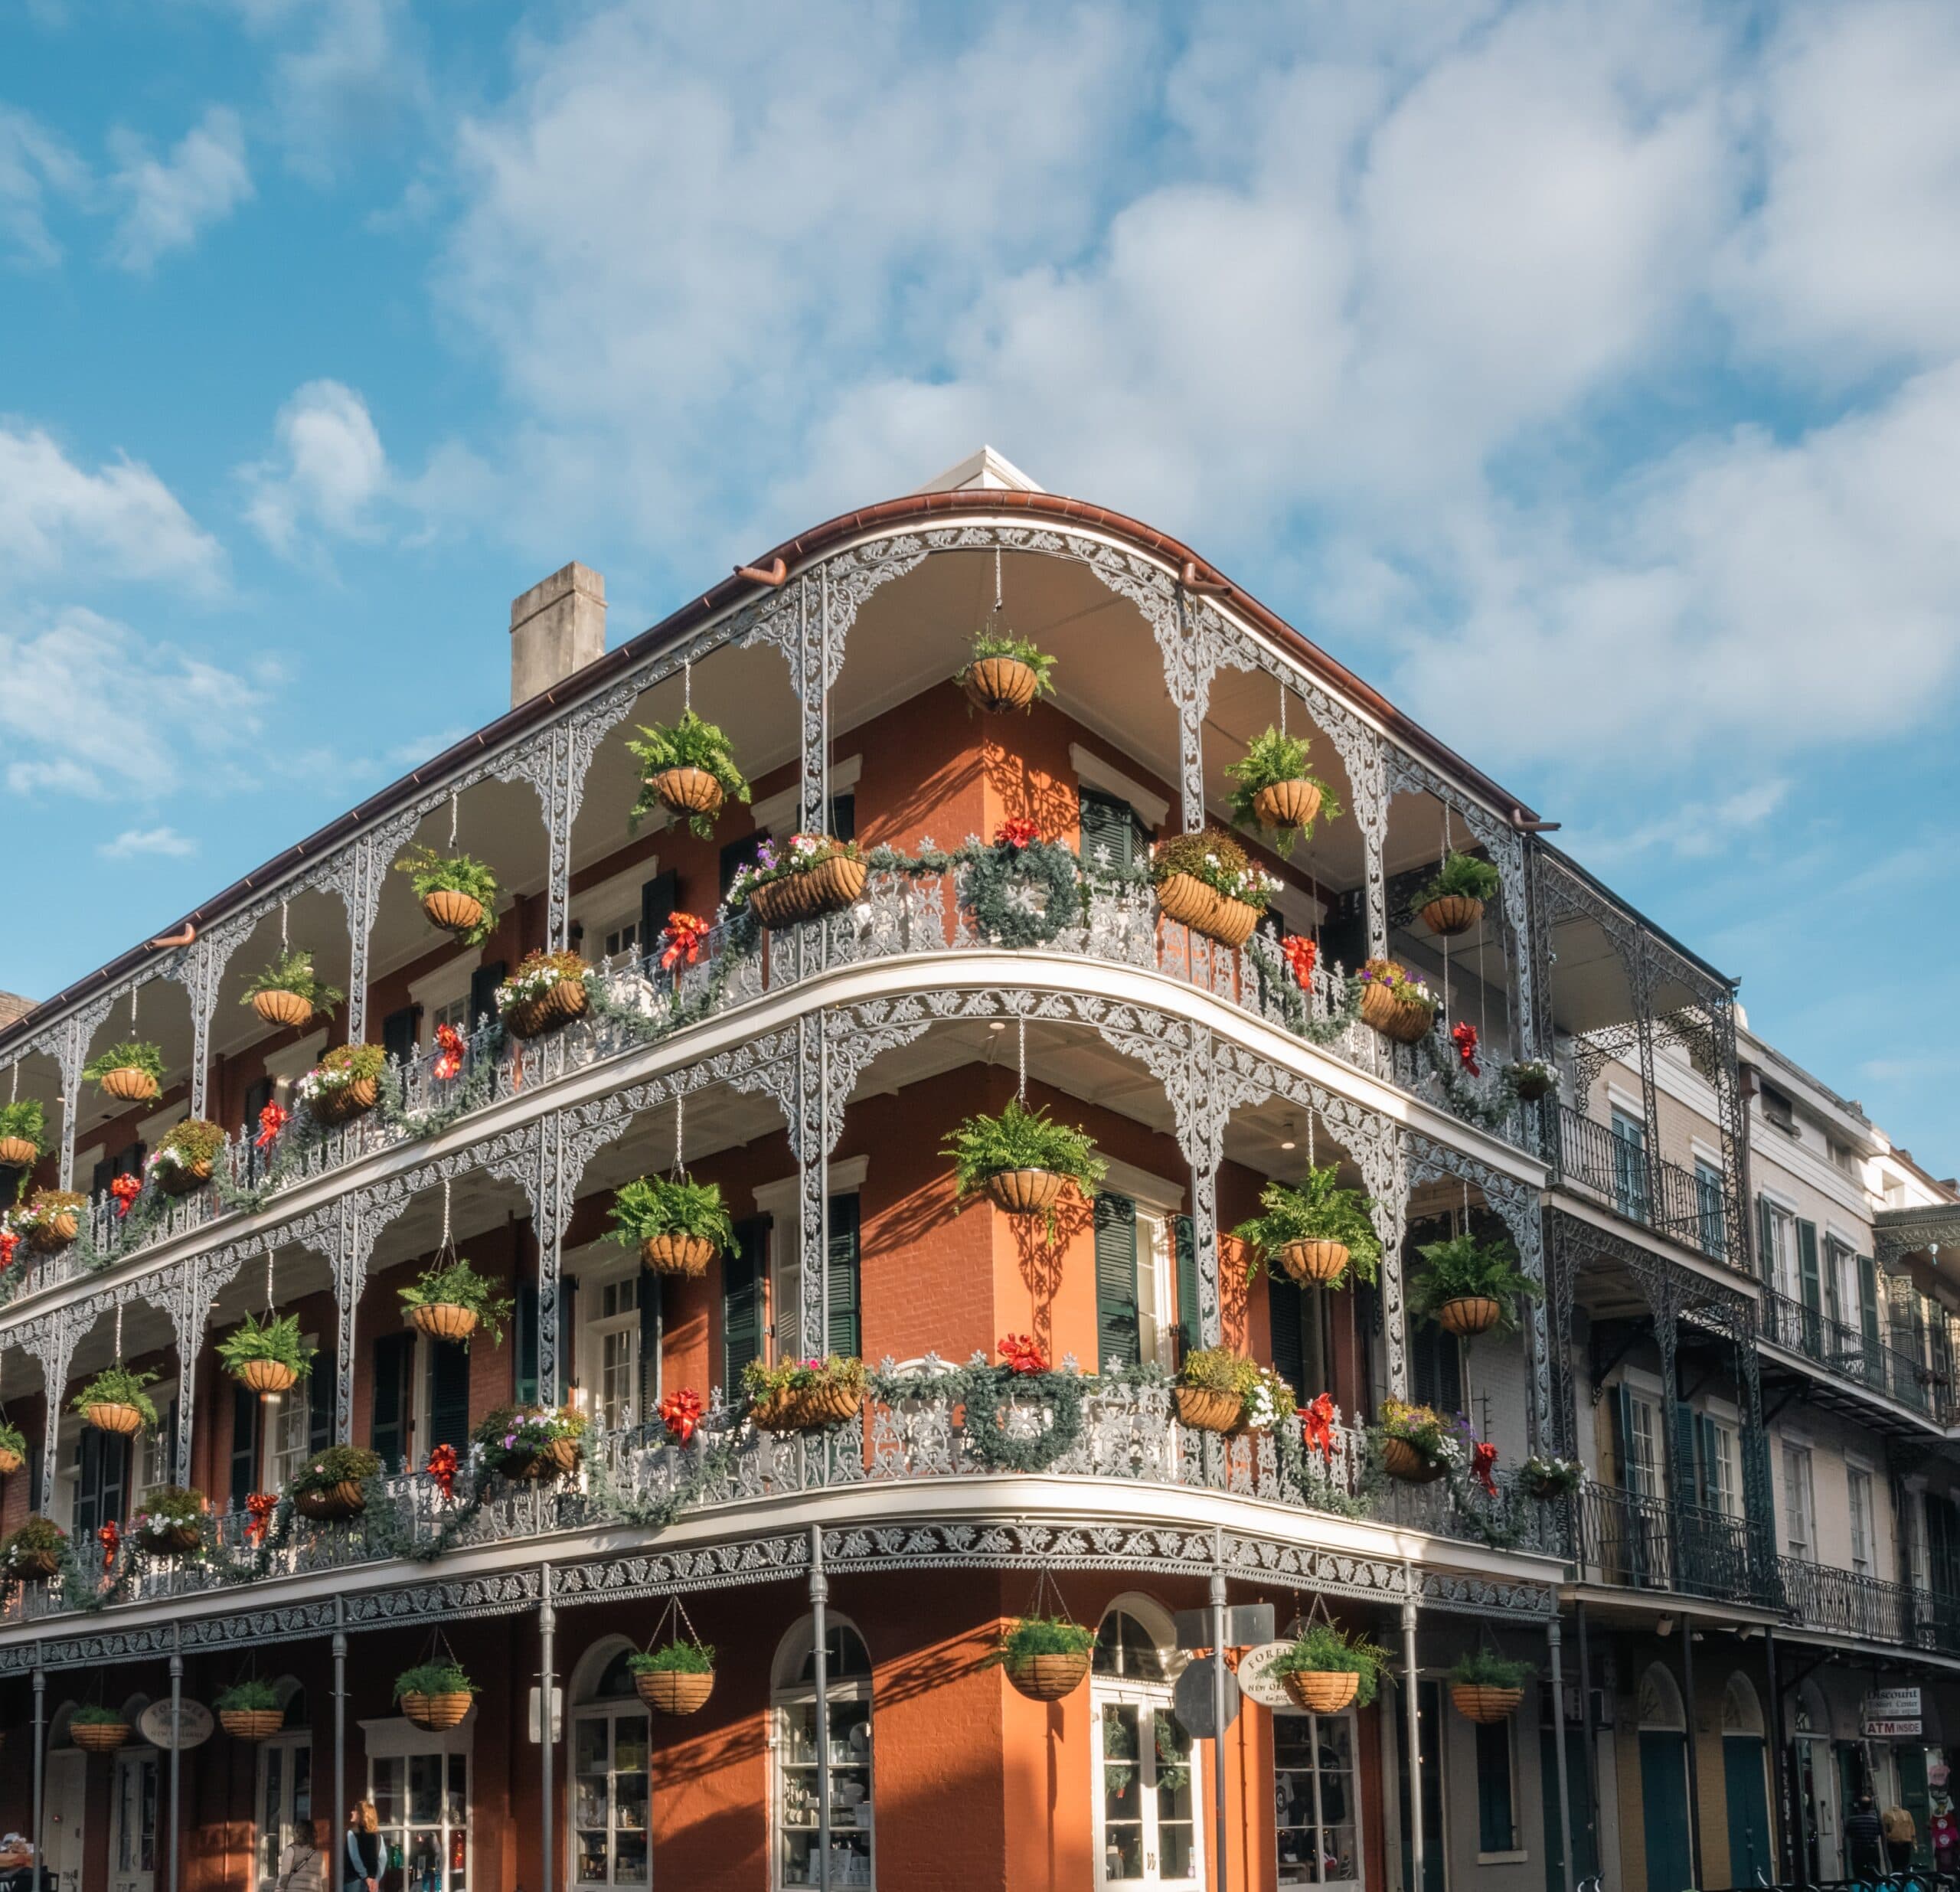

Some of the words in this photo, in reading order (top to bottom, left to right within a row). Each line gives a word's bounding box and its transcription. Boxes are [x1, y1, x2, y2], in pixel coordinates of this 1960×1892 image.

[1248, 1648, 1294, 1669] FOREV
[1867, 1723, 1894, 1734] ATM
[1896, 1723, 1920, 1732] INSIDE
